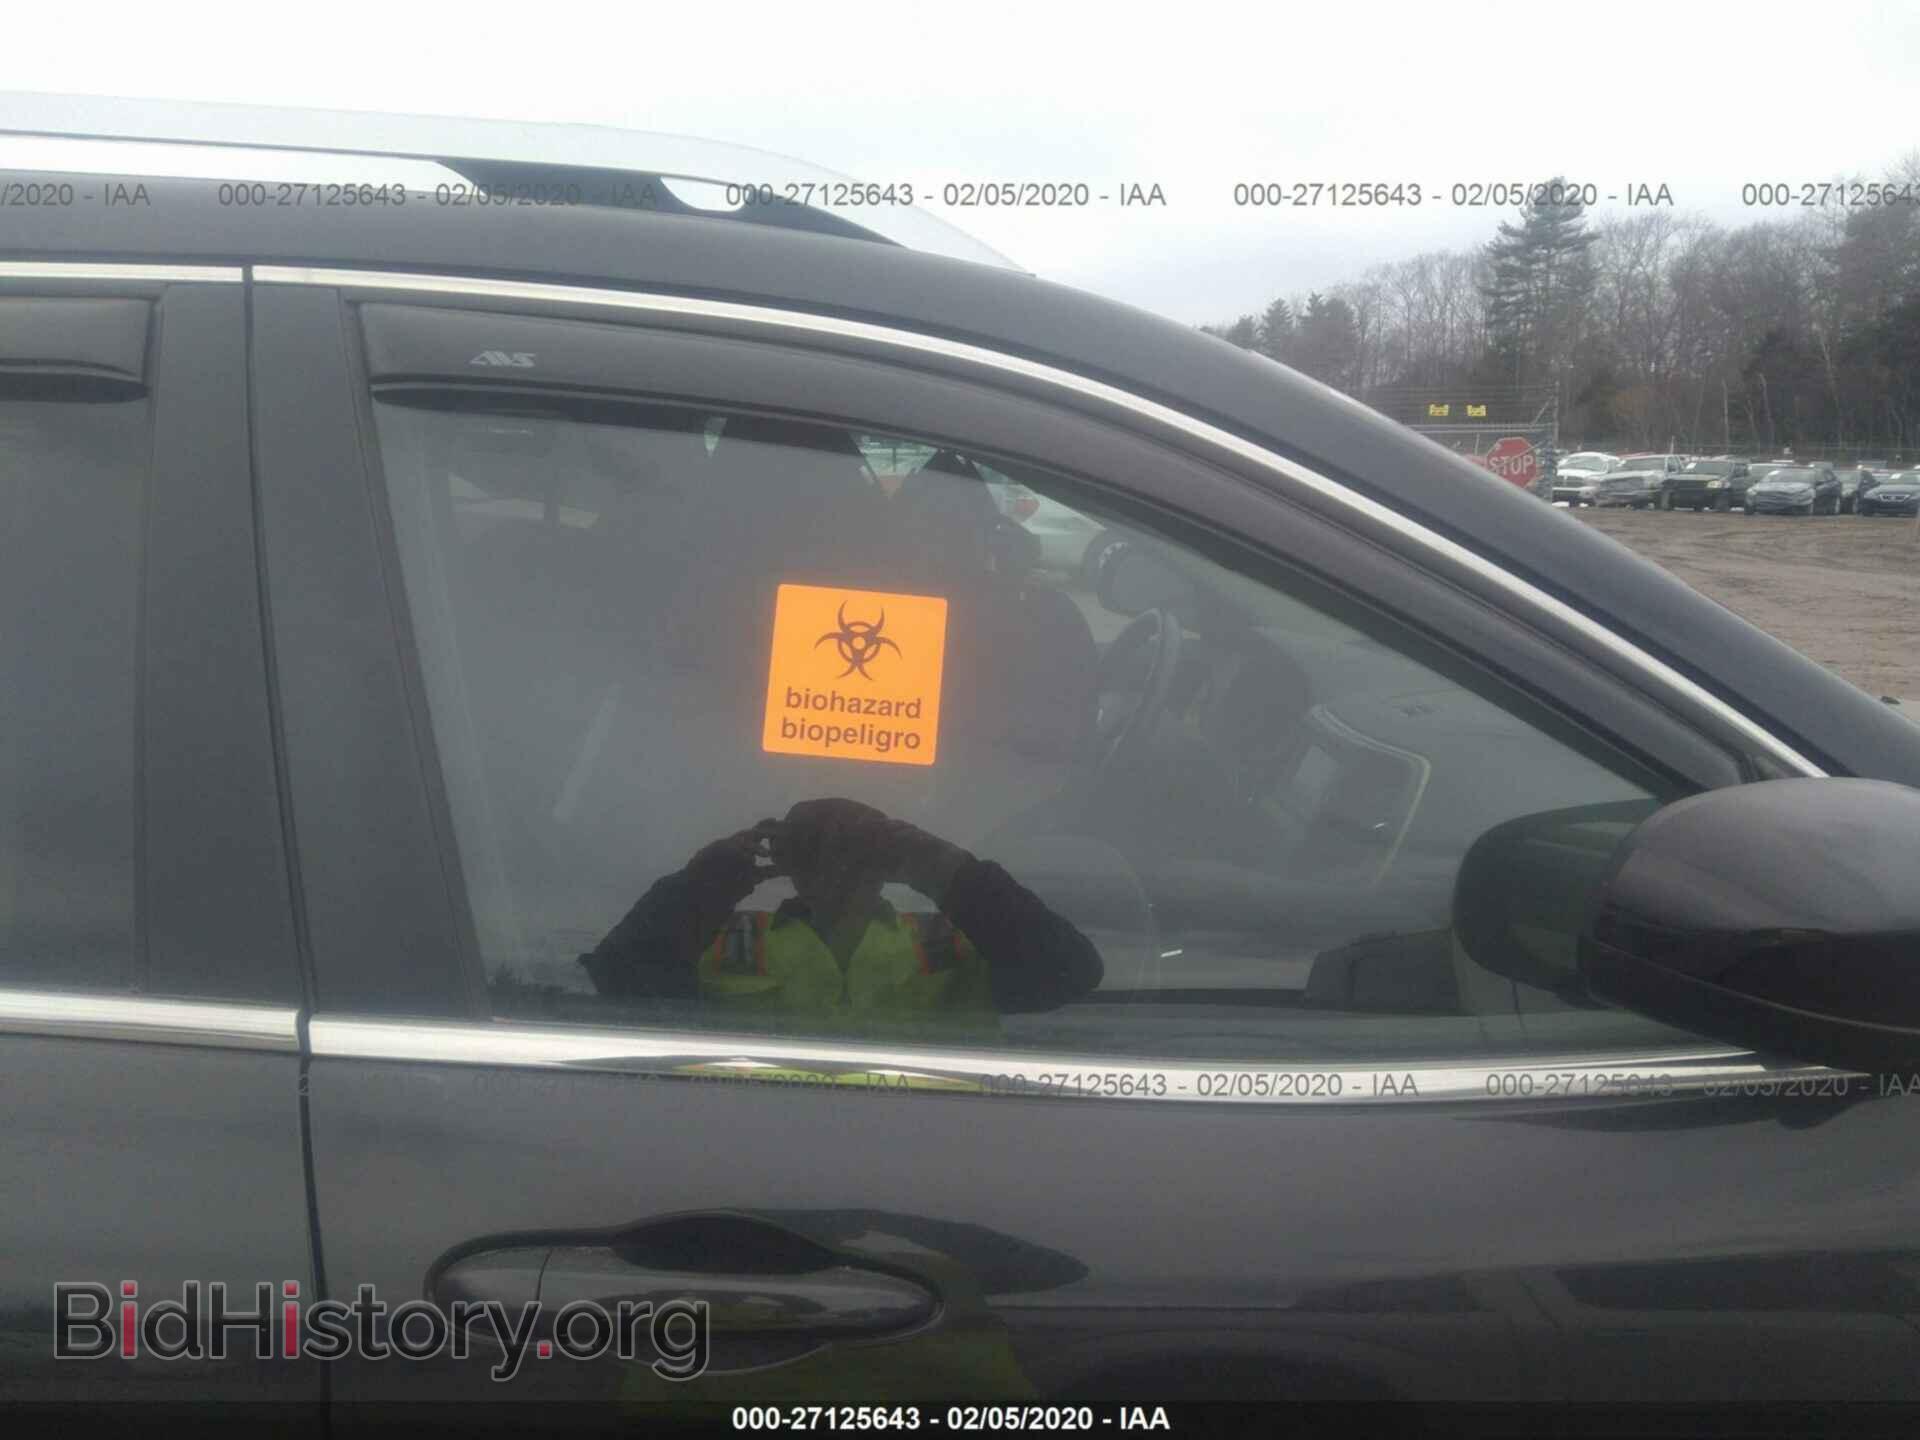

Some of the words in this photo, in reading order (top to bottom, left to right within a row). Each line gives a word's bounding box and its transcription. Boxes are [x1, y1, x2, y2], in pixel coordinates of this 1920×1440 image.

[1489, 455, 1534, 475] STOP
[785, 686, 921, 719] biohazard
[780, 716, 921, 752] biopeligro
